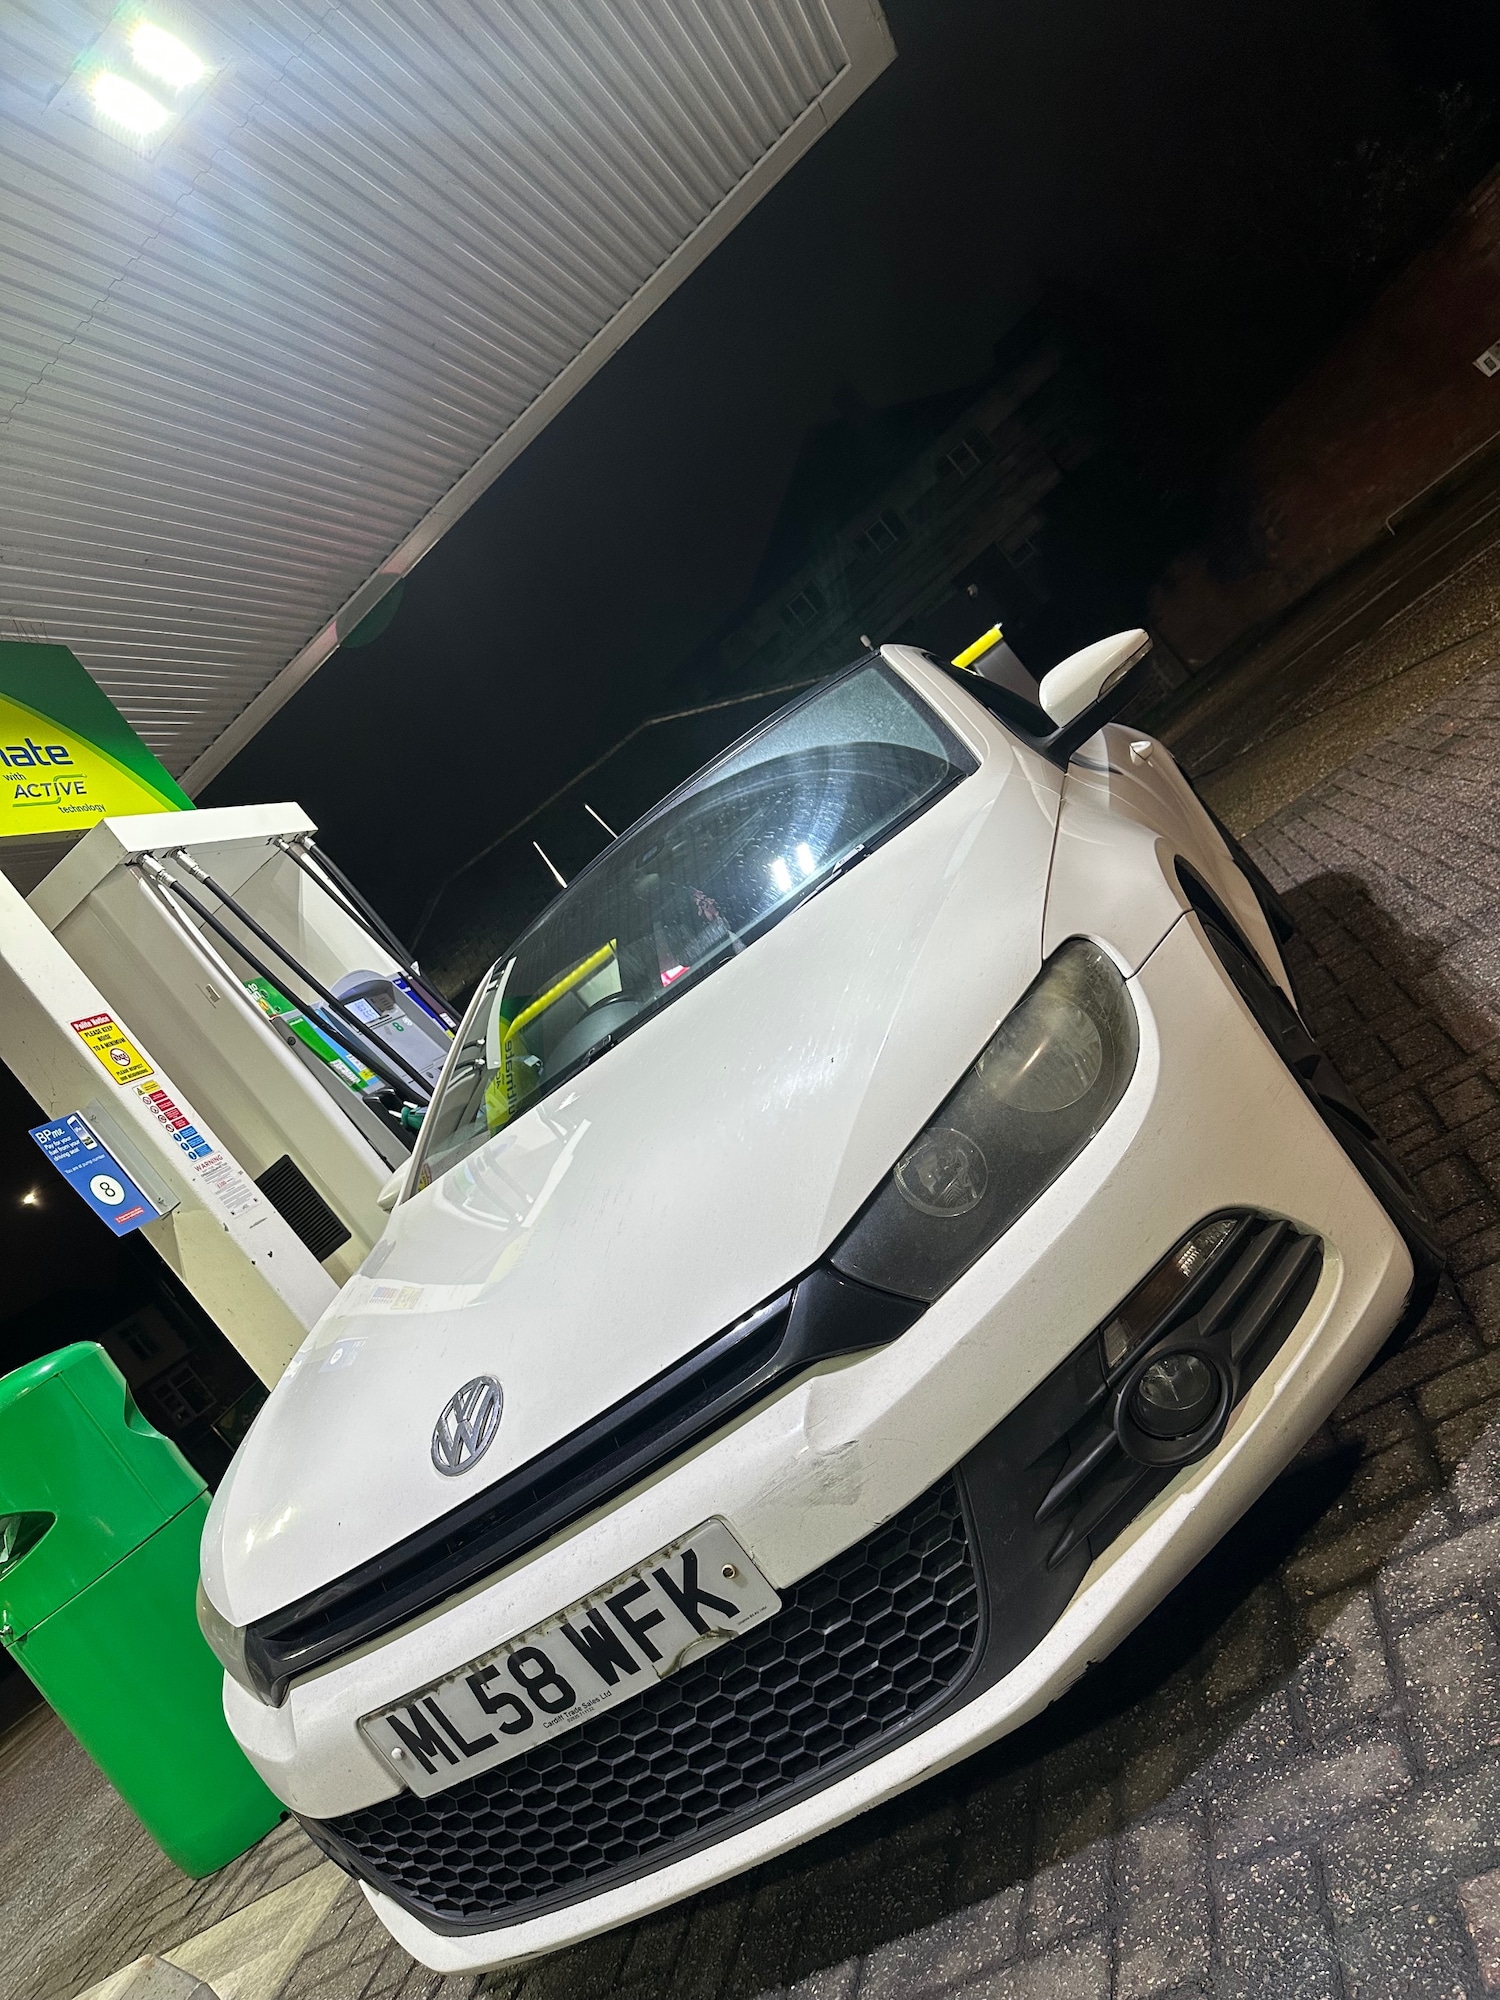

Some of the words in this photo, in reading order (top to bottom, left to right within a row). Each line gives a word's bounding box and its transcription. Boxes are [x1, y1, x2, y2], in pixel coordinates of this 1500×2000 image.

[2, 772, 27, 781] with
[14, 781, 87, 799] ACTIVE
[57, 803, 106, 815] technology
[73, 1020, 93, 1031] Polite
[90, 1015, 111, 1027] Notice
[392, 1022, 404, 1035] 8
[84, 1028, 103, 1038] PLEASE
[100, 1025, 113, 1033] KEEP
[97, 1034, 112, 1042] NOISE
[103, 1037, 126, 1048] MINIMUM
[116, 1068, 129, 1076] PLEASE
[43, 1143, 55, 1151] Pay
[60, 1136, 72, 1144] your
[48, 1148, 59, 1156] fuel
[57, 1144, 70, 1152] from
[69, 1140, 80, 1148] your
[53, 1151, 71, 1162] driving
[69, 1147, 80, 1155] seat
[91, 1154, 105, 1162] number
[194, 1154, 224, 1172] WARNING
[99, 1182, 116, 1198] 8
[385, 1646, 577, 1775] ML58
[560, 1548, 741, 1687] WFK
[542, 1715, 565, 1729] Cardiff
[563, 1706, 582, 1718] Trade
[581, 1697, 601, 1709] Sales
[599, 1690, 613, 1700] Ltd
